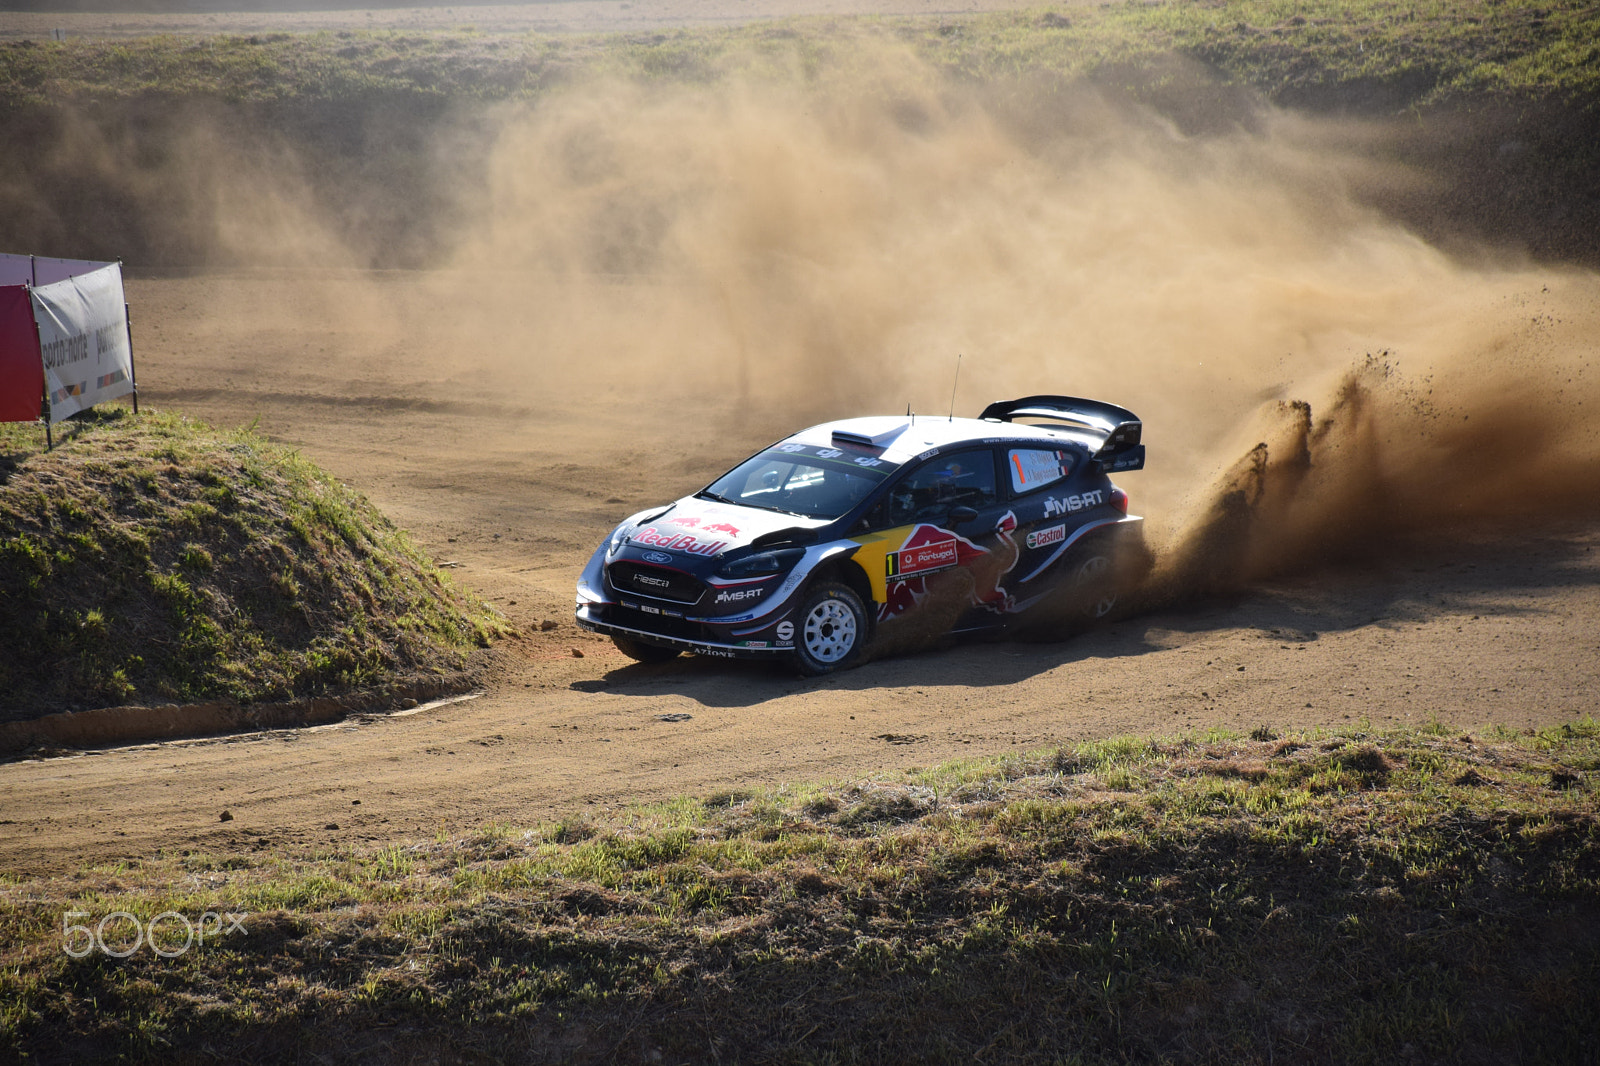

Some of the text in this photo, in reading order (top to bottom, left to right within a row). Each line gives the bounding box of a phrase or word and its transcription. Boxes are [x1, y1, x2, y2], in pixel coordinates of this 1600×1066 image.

[1012, 454, 1026, 484] 1
[632, 527, 728, 556] Red Bull
[1037, 526, 1063, 545] Castrol
[887, 554, 893, 575] 1
[918, 548, 955, 562] Portugal
